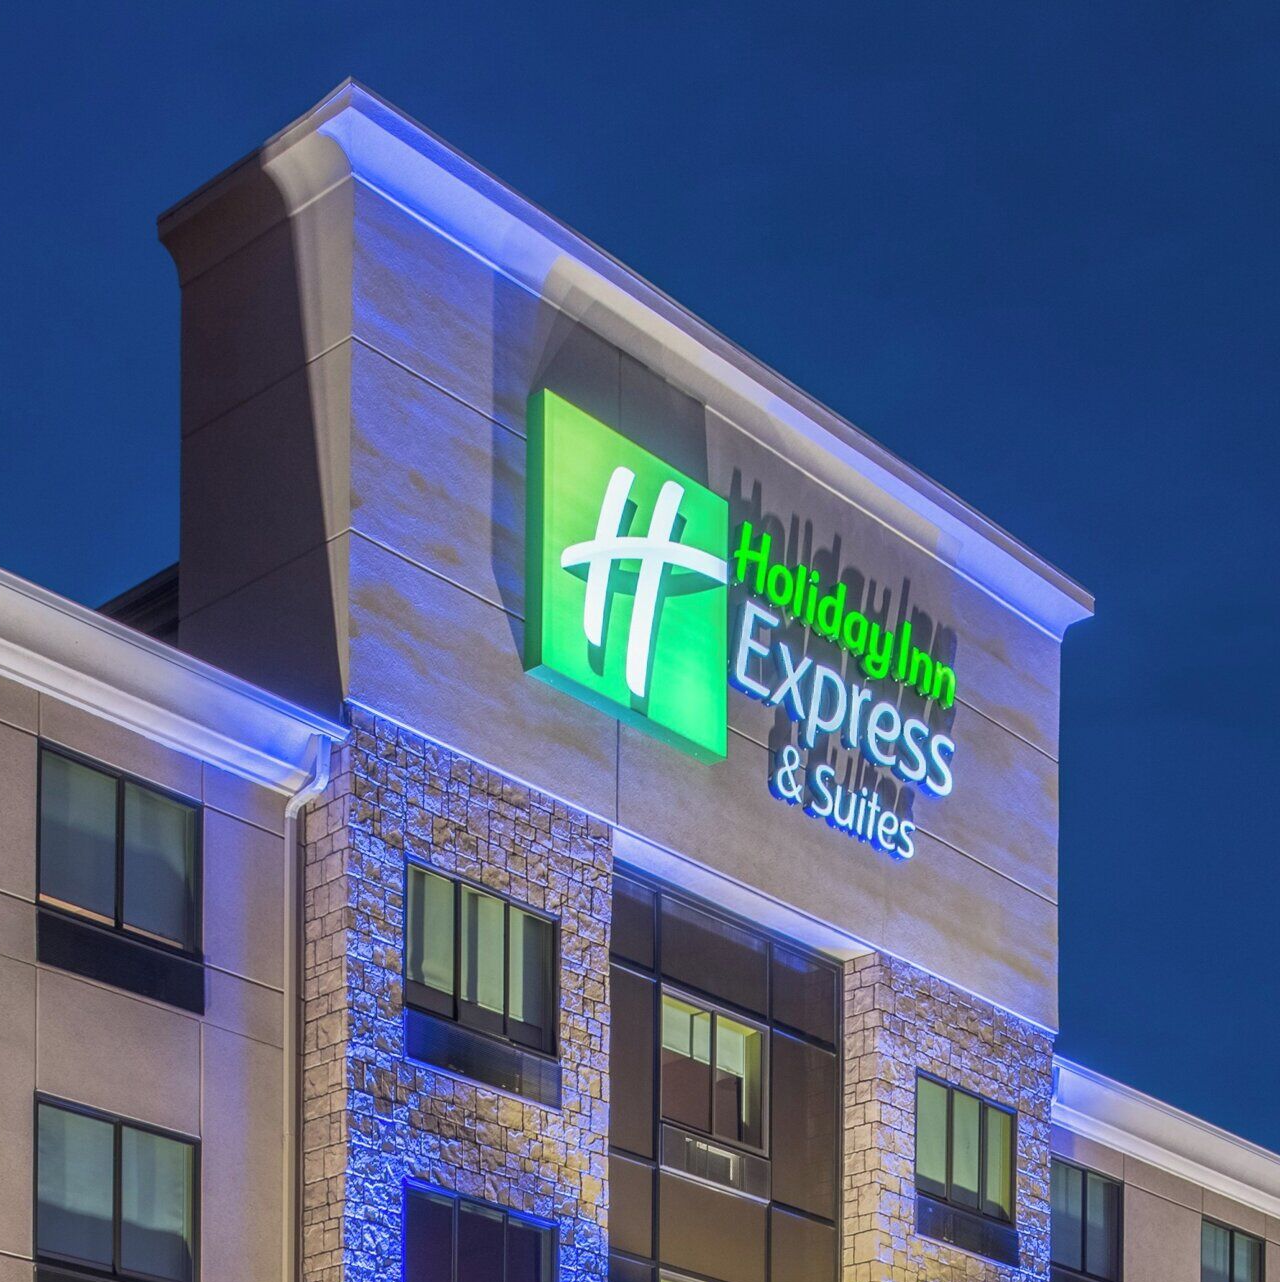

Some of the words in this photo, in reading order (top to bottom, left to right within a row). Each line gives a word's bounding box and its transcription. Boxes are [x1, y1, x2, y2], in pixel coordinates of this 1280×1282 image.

[733, 520, 894, 680] Holiday
[896, 620, 957, 710] Inn
[735, 600, 956, 798] Express
[776, 744, 803, 804] &
[811, 764, 916, 860] Suites
